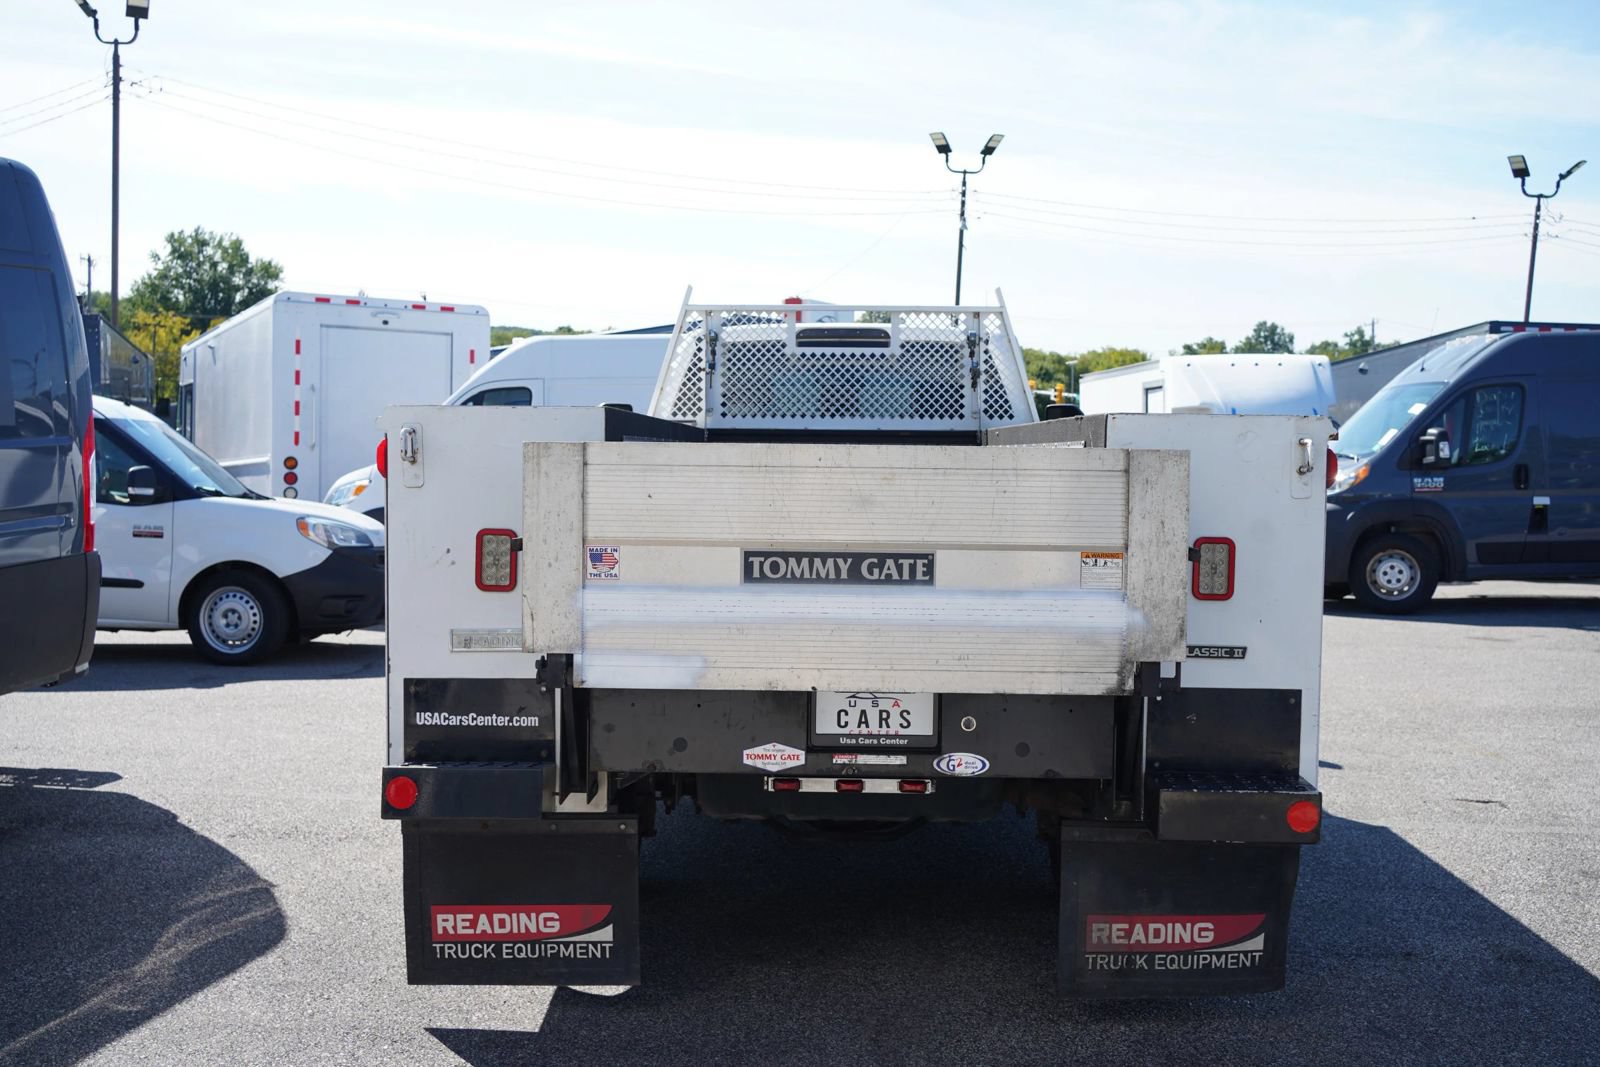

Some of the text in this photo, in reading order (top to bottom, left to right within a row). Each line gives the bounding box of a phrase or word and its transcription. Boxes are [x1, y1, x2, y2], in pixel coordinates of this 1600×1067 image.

[748, 556, 931, 581] TOMMY GATE
[1186, 647, 1244, 658] LASSIC II
[848, 699, 901, 708] USA
[415, 711, 540, 727] USACarsCenter.com
[836, 709, 912, 729] CARS
[839, 737, 908, 745] Usa Cars Center
[745, 753, 777, 761] TOMMY
[436, 912, 561, 935] READING
[1091, 922, 1215, 944] READING
[432, 943, 613, 959] TRUCK EQUIPMENT
[1154, 952, 1263, 970] EQUIPMENT
